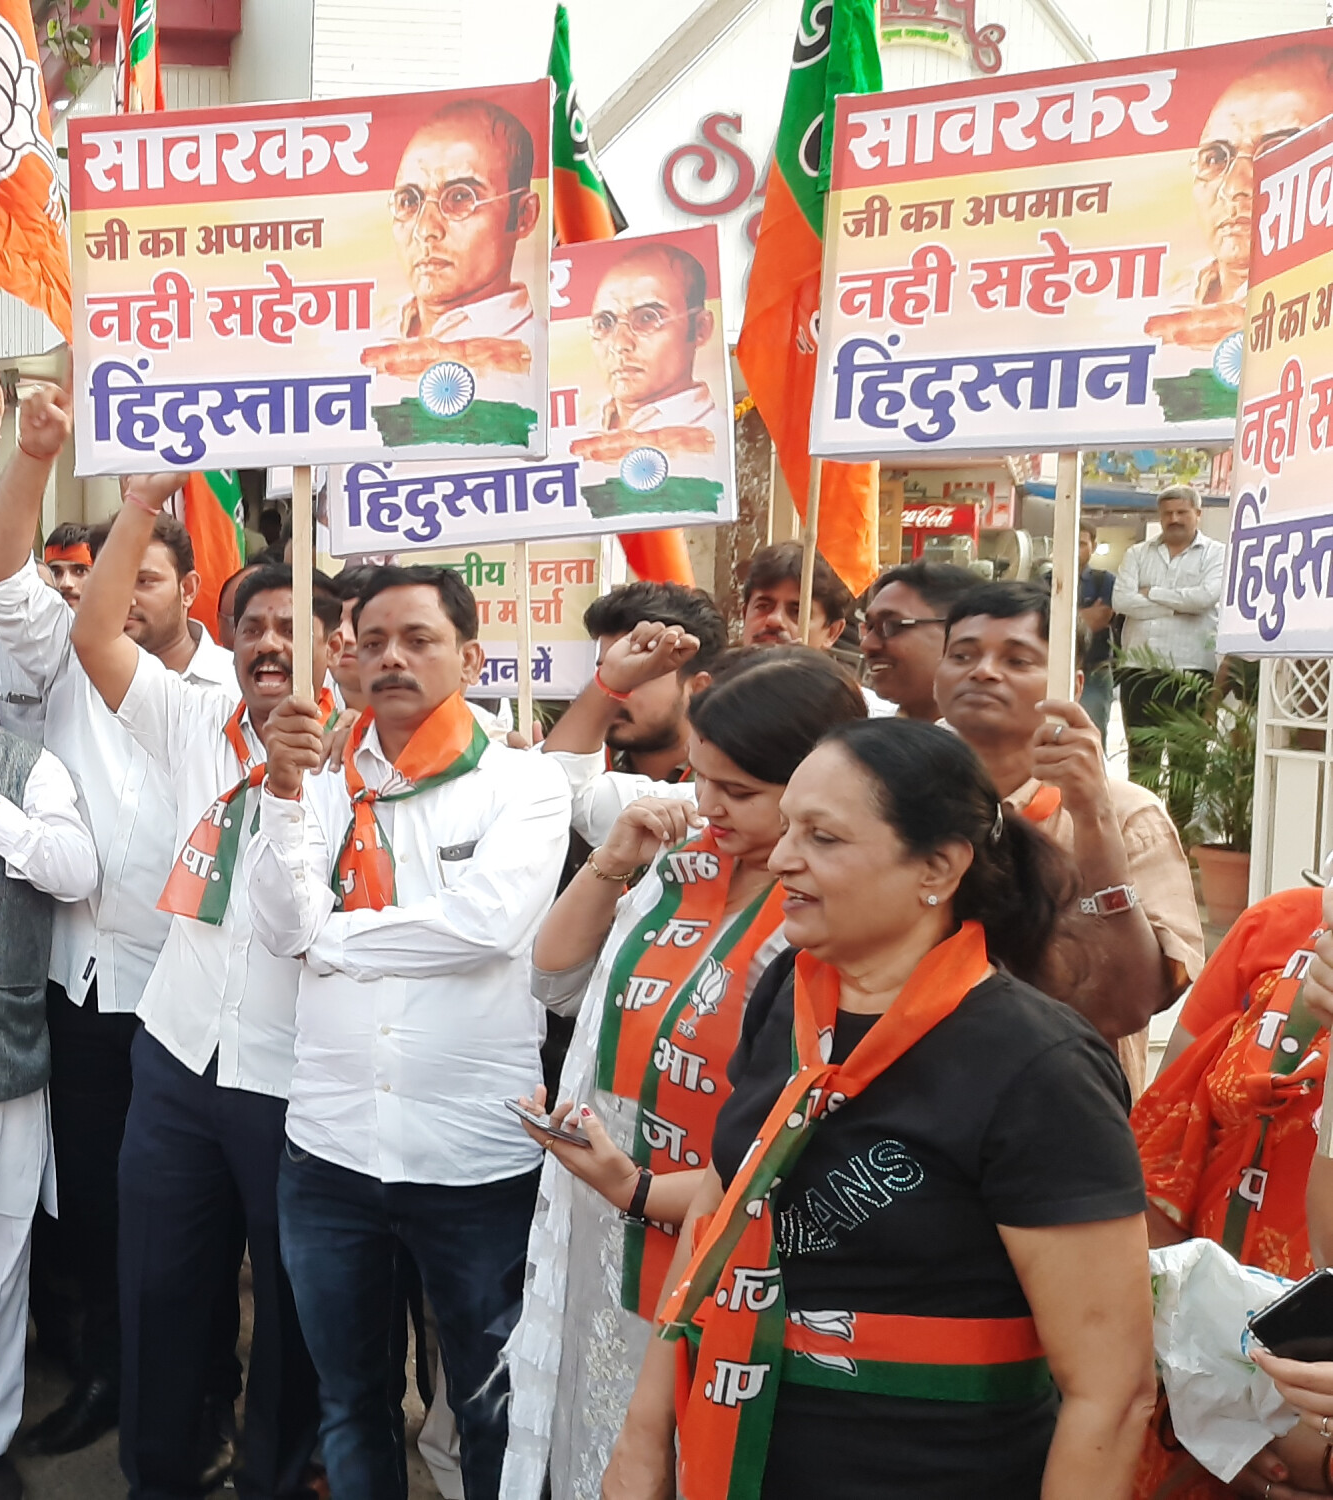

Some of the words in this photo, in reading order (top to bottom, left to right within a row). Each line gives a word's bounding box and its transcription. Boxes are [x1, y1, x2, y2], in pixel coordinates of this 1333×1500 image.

[81, 112, 373, 193] सावरकर
[847, 69, 1178, 171] सावरकर
[85, 218, 130, 262] जी
[138, 227, 187, 259] का
[196, 218, 325, 255] अपमान
[843, 194, 891, 239] जी
[900, 199, 954, 233] का
[963, 182, 1113, 226] अपमान
[86, 272, 194, 350] नही
[206, 264, 375, 344] सहेगा
[838, 246, 957, 327] नही
[970, 231, 1168, 316] सहेगा
[1249, 292, 1275, 354] जी
[1279, 292, 1310, 343] का
[89, 358, 371, 465] हिंदुस्तान
[833, 334, 1156, 443] हिंदुस्तान
[1241, 360, 1303, 474] नही
[343, 461, 580, 543] हिंदुस्तान
[653, 1036, 716, 1095] भा.
[641, 1108, 701, 1167] ज.
